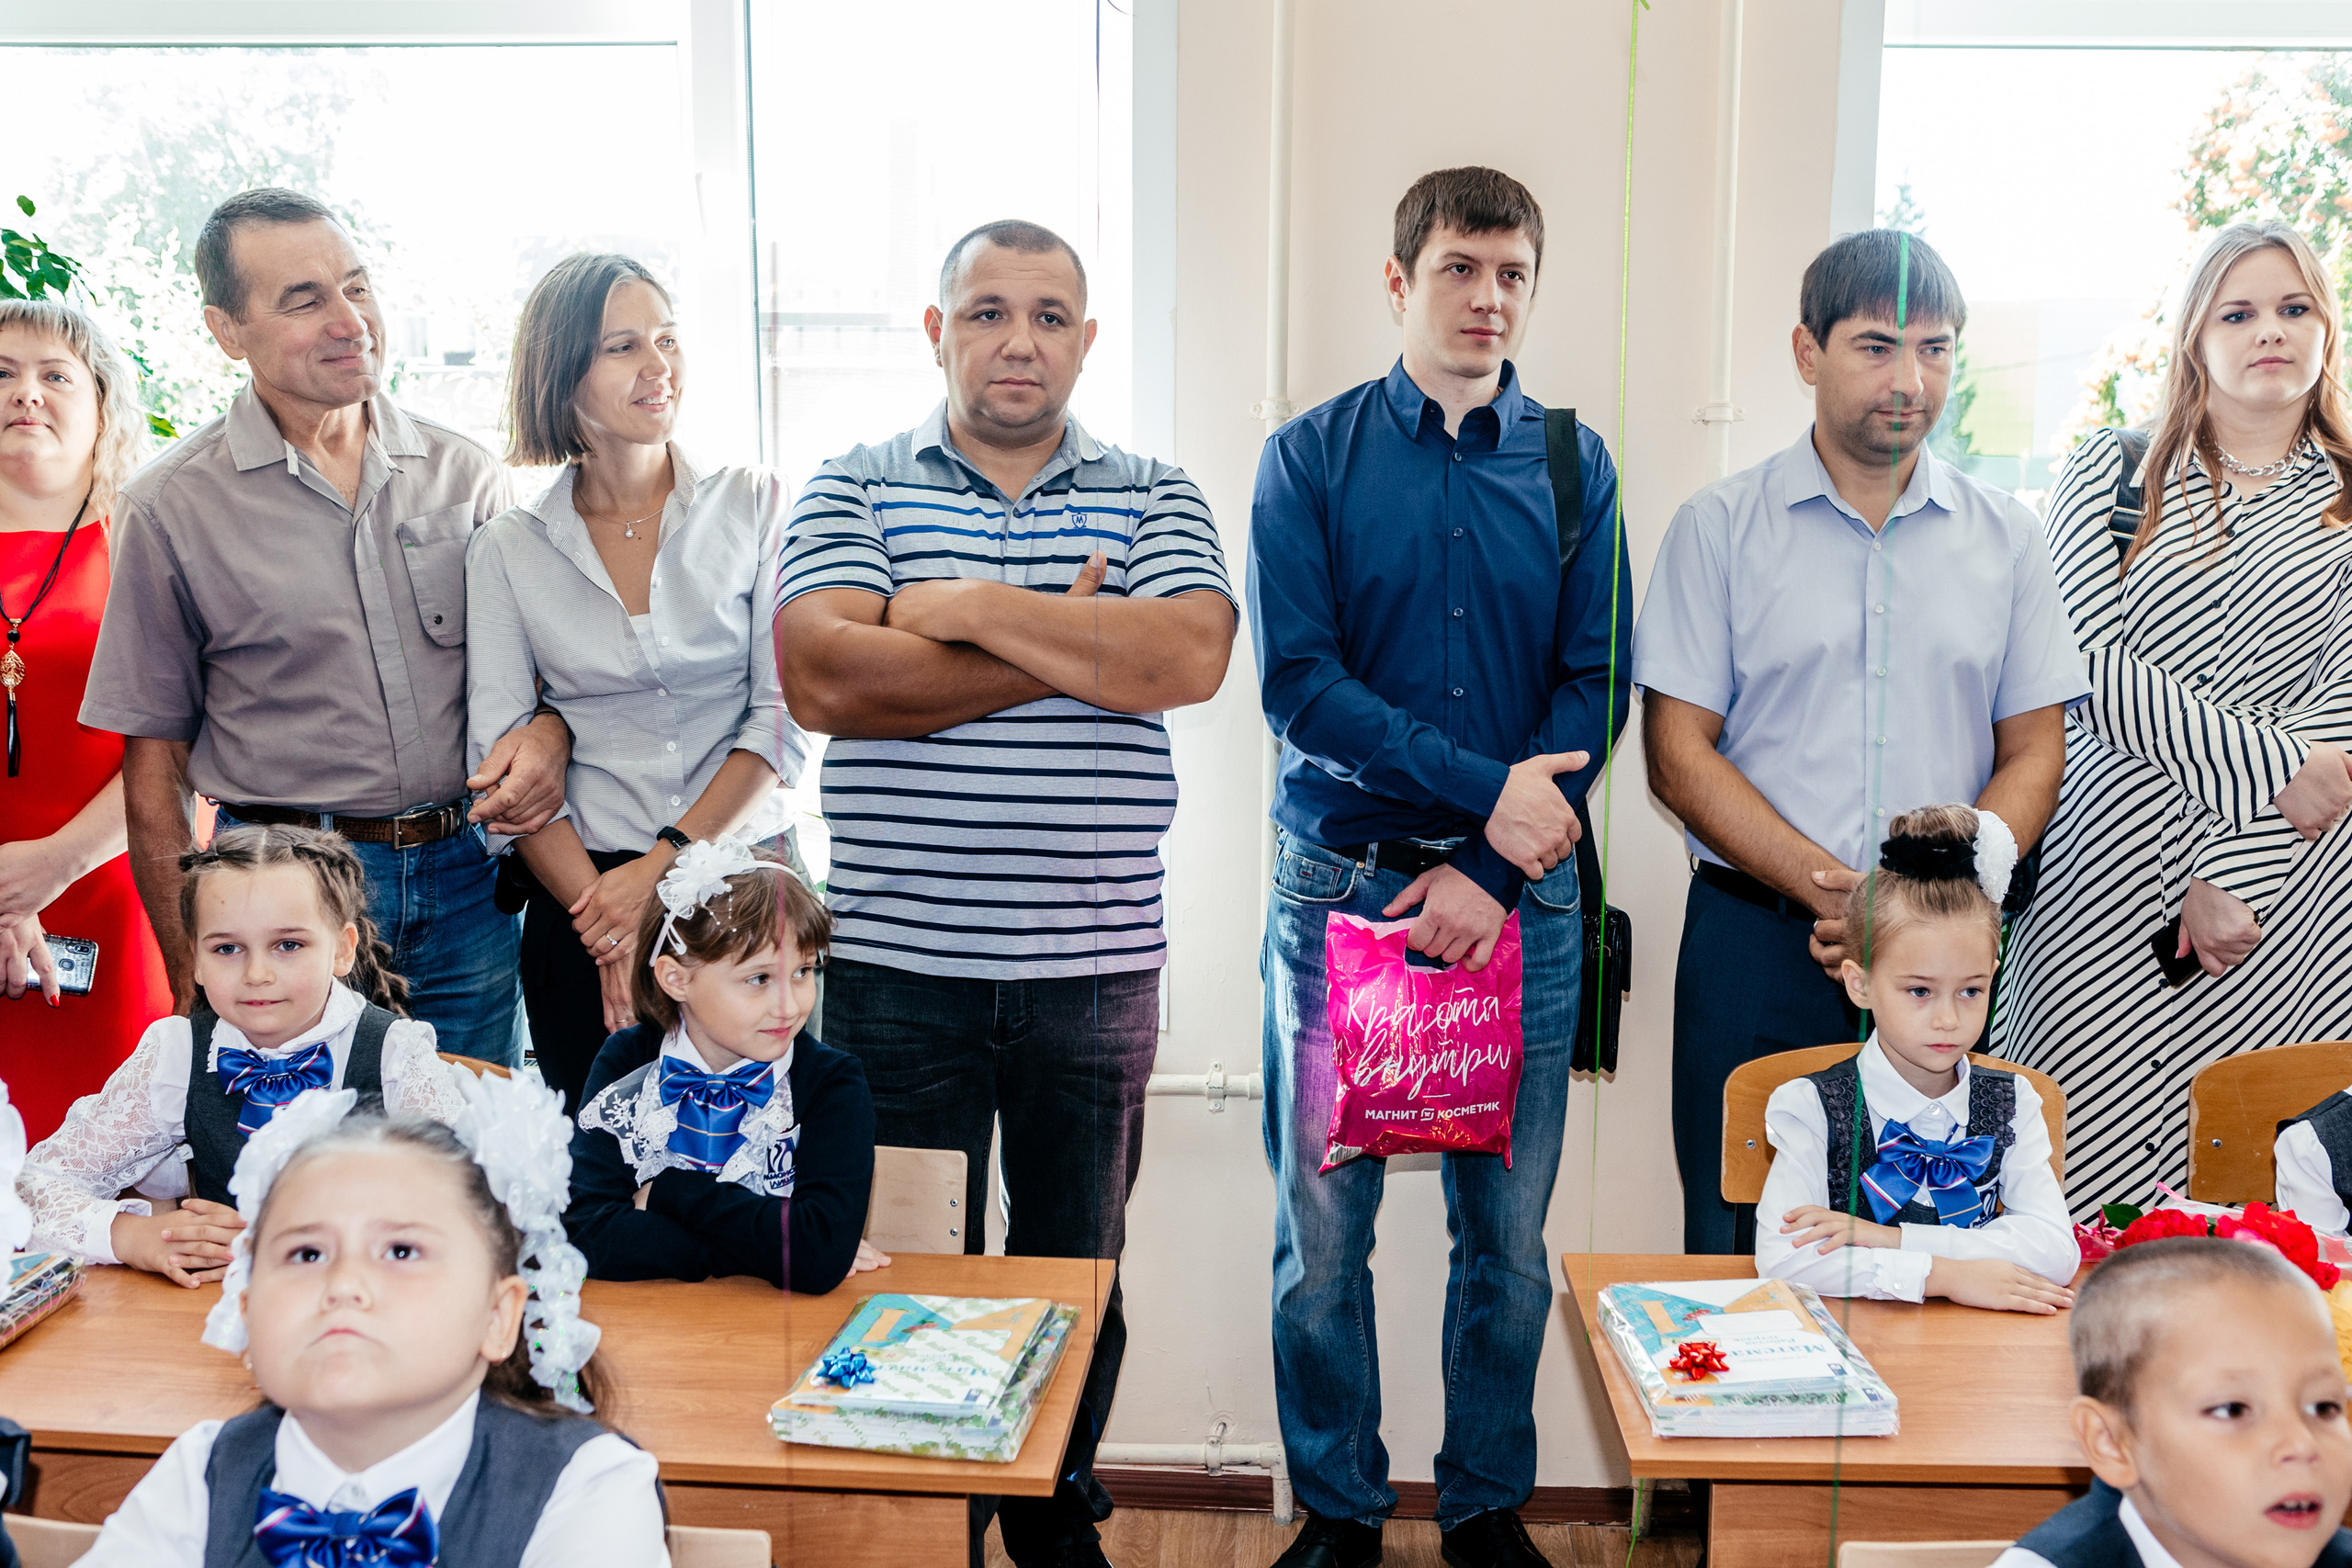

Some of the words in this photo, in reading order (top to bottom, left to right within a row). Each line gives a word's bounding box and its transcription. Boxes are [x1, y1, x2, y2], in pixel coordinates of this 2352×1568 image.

[1346, 987, 1500, 1043] Красота
[1353, 1028, 1511, 1100] внутри
[1364, 1109, 1418, 1121] МАГНИТ
[1437, 1101, 1500, 1120] КОСМЕТИК
